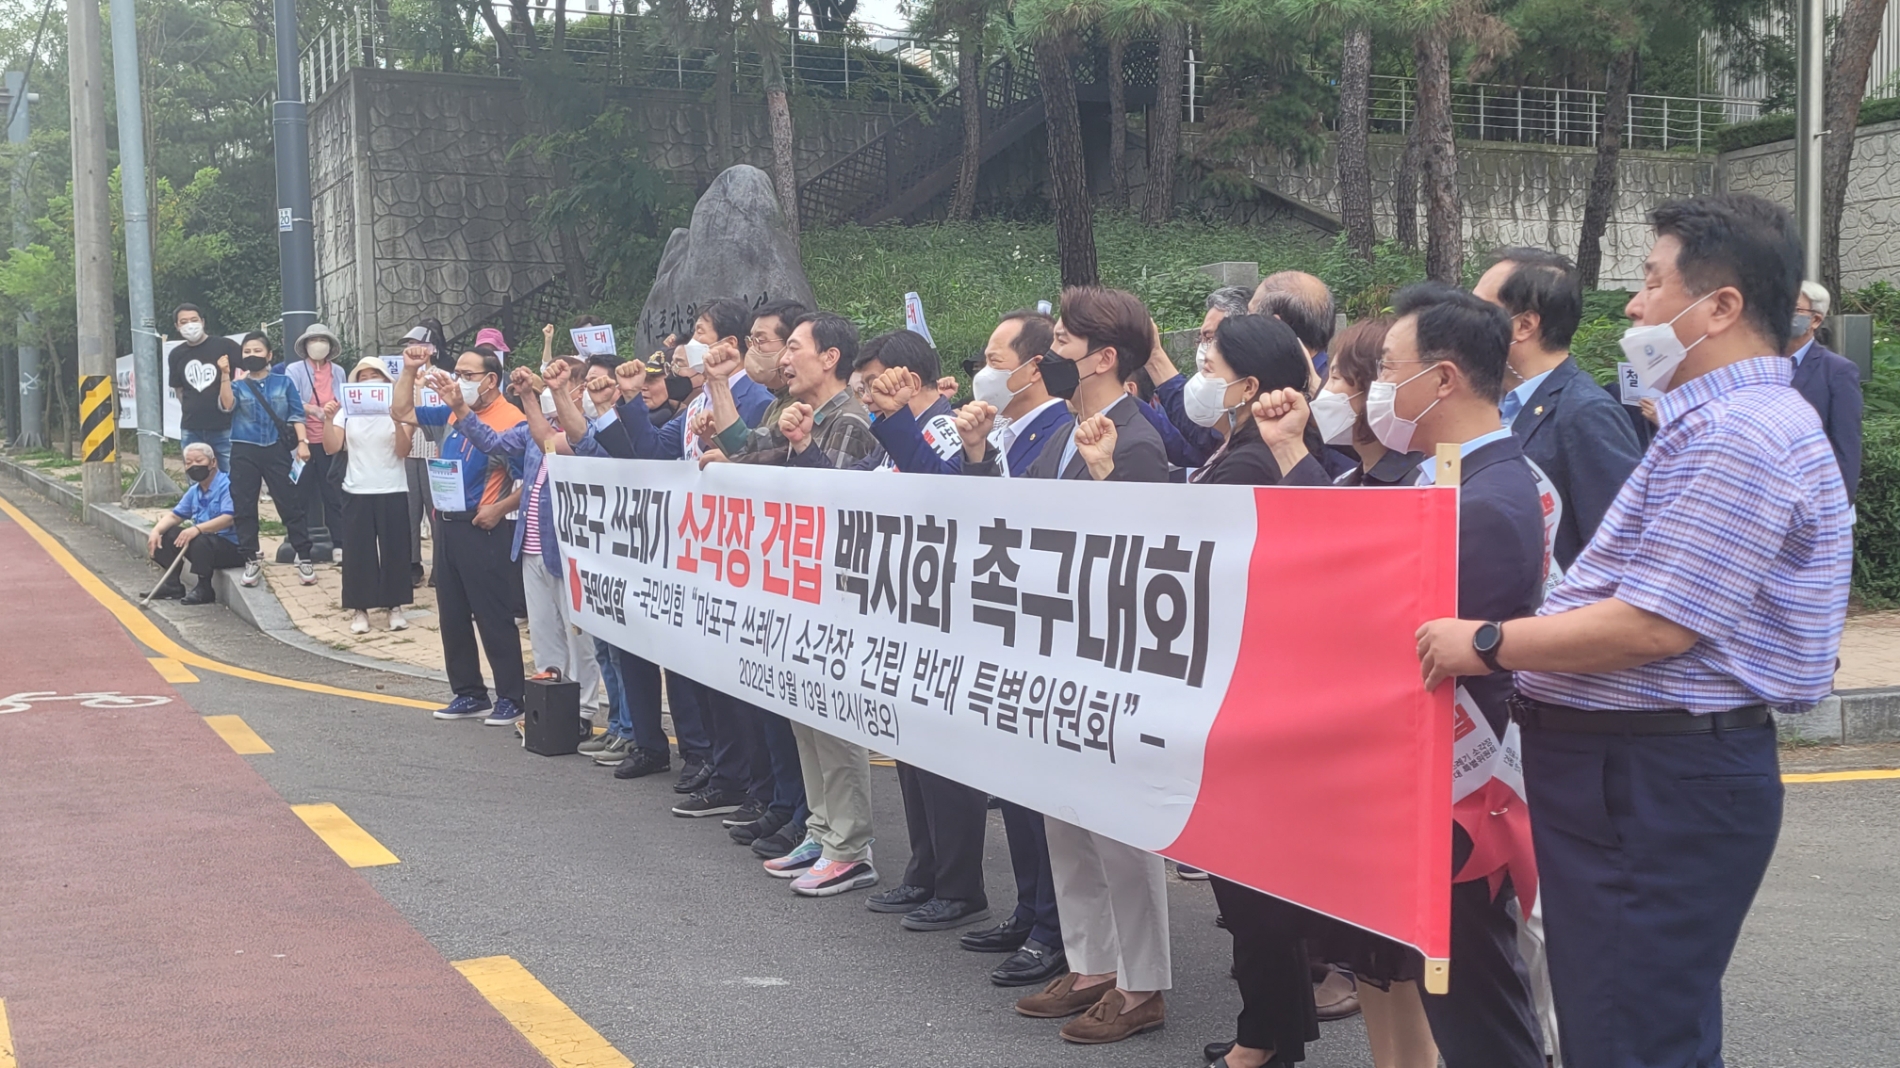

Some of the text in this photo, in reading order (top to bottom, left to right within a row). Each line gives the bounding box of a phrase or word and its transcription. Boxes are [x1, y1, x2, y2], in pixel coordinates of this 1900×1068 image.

[555, 480, 606, 554] 마포구
[611, 486, 672, 569] 쓰레기
[676, 492, 756, 588] 소각장
[761, 501, 826, 605] 건립
[834, 509, 958, 633] 백지화
[970, 517, 1216, 688] 촉구대회
[581, 569, 627, 626] 국민의힘
[738, 657, 900, 746] 2022년 9월 13일 12시(정오)
[740, 606, 792, 663] 쓰레기
[792, 619, 854, 681] 소각장
[861, 635, 908, 697] 건립
[911, 646, 965, 715] 반대
